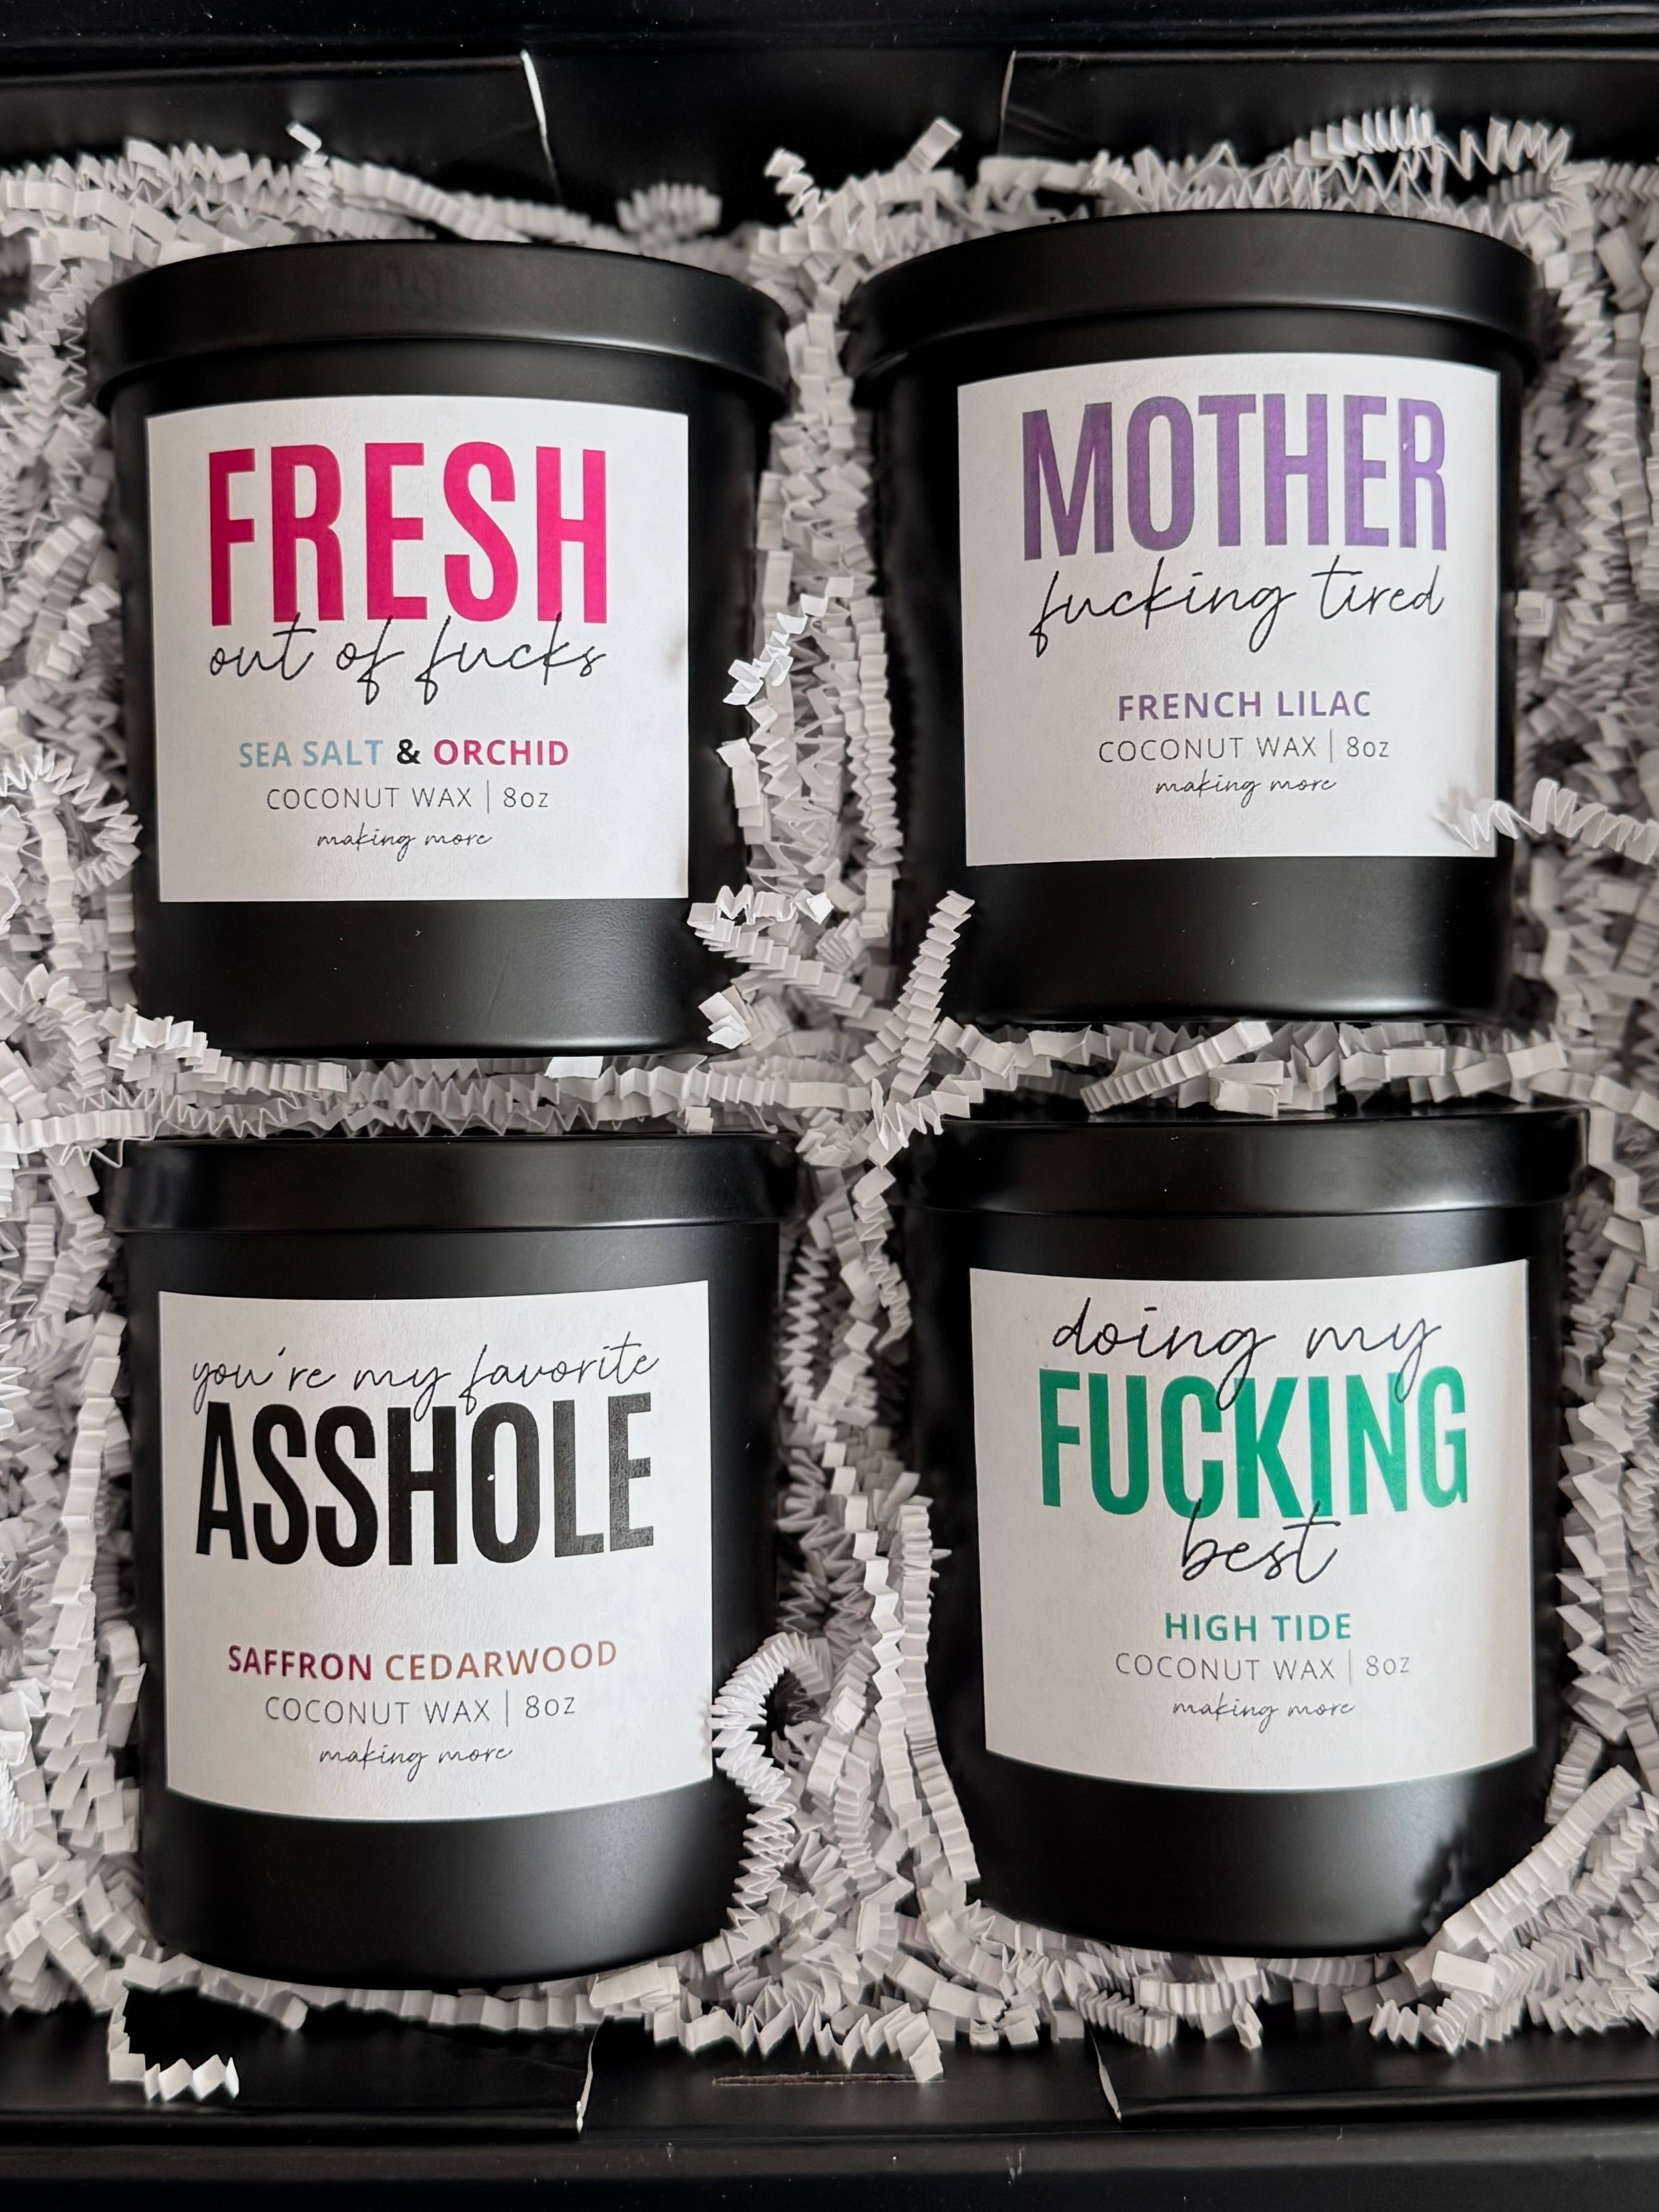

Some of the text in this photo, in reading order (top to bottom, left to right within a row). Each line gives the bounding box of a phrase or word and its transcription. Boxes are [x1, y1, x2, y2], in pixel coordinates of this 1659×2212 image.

[1022, 393, 1447, 561] MOTHER
[208, 441, 607, 627] FRESH
[1029, 554, 1444, 658] fucking tired
[209, 612, 607, 706] out of fucks
[1119, 691, 1370, 722] FRENCH LILAC
[240, 739, 568, 768] SEA SALT & ORCHID
[1099, 737, 1244, 763] COCONUT
[1256, 736, 1316, 758] WAX
[1347, 736, 1389, 757] 8oz
[267, 787, 400, 810] COCONUT
[412, 787, 472, 807] WAX
[503, 787, 548, 807] 8oz
[1156, 768, 1337, 808] making more
[317, 822, 492, 862] making more
[1052, 1297, 1442, 1411] doing my
[192, 1331, 659, 1421] you're my favorite
[1039, 1365, 1468, 1519] FUCKING
[196, 1391, 654, 1567] ASSHOLE
[1182, 1499, 1341, 1584] best
[1165, 1613, 1351, 1642] HIGH TIDE
[228, 1641, 616, 1682] SAFFRON CEDARWOOD
[1116, 1652, 1260, 1681] COCONUT
[1273, 1659, 1334, 1681] WAX
[1366, 1655, 1409, 1676] 8oz
[265, 1696, 410, 1725] COCONUT
[424, 1699, 490, 1724] WAX
[526, 1695, 575, 1718] 8oz
[1173, 1692, 1355, 1734] making more
[319, 1736, 513, 1783] making more
